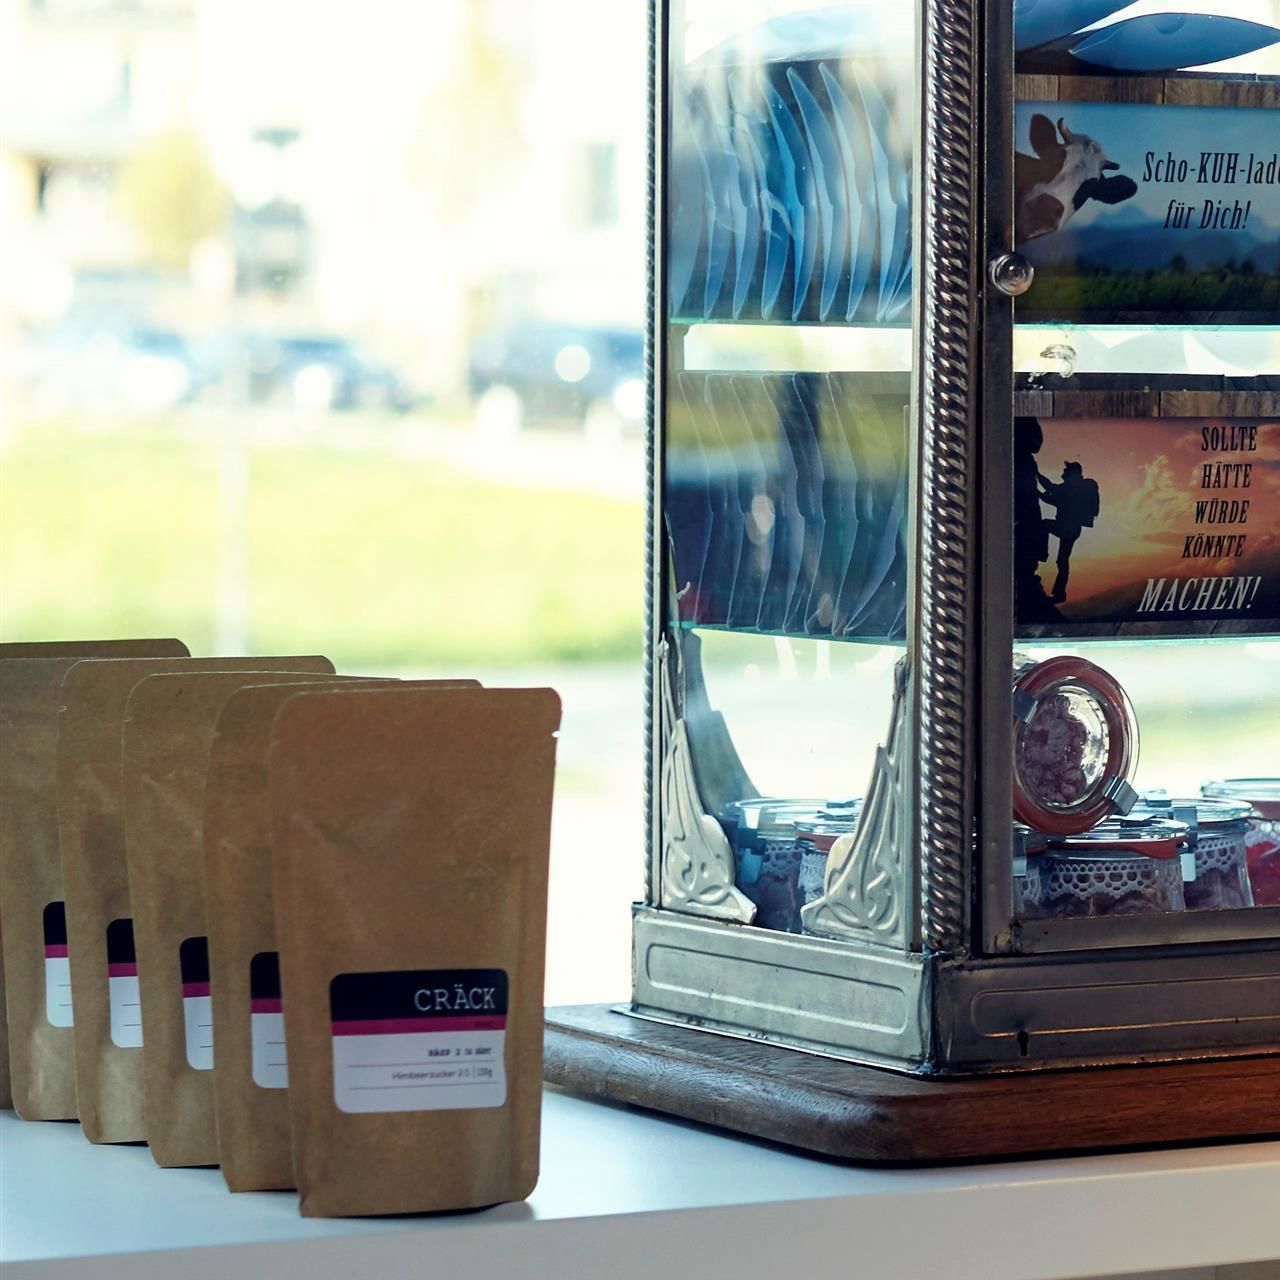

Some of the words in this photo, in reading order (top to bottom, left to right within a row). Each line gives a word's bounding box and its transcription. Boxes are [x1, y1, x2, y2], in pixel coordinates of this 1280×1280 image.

[1163, 199, 1195, 229] für
[1199, 199, 1251, 229] Dich!
[1202, 426, 1257, 451] SOLLTE
[1201, 461, 1252, 488] HÄTTE
[1195, 498, 1249, 524] WÜRDE
[1182, 533, 1246, 558] KÖNNTE
[1137, 576, 1262, 612] MACHEN!
[415, 984, 495, 1011] CRÄCK
